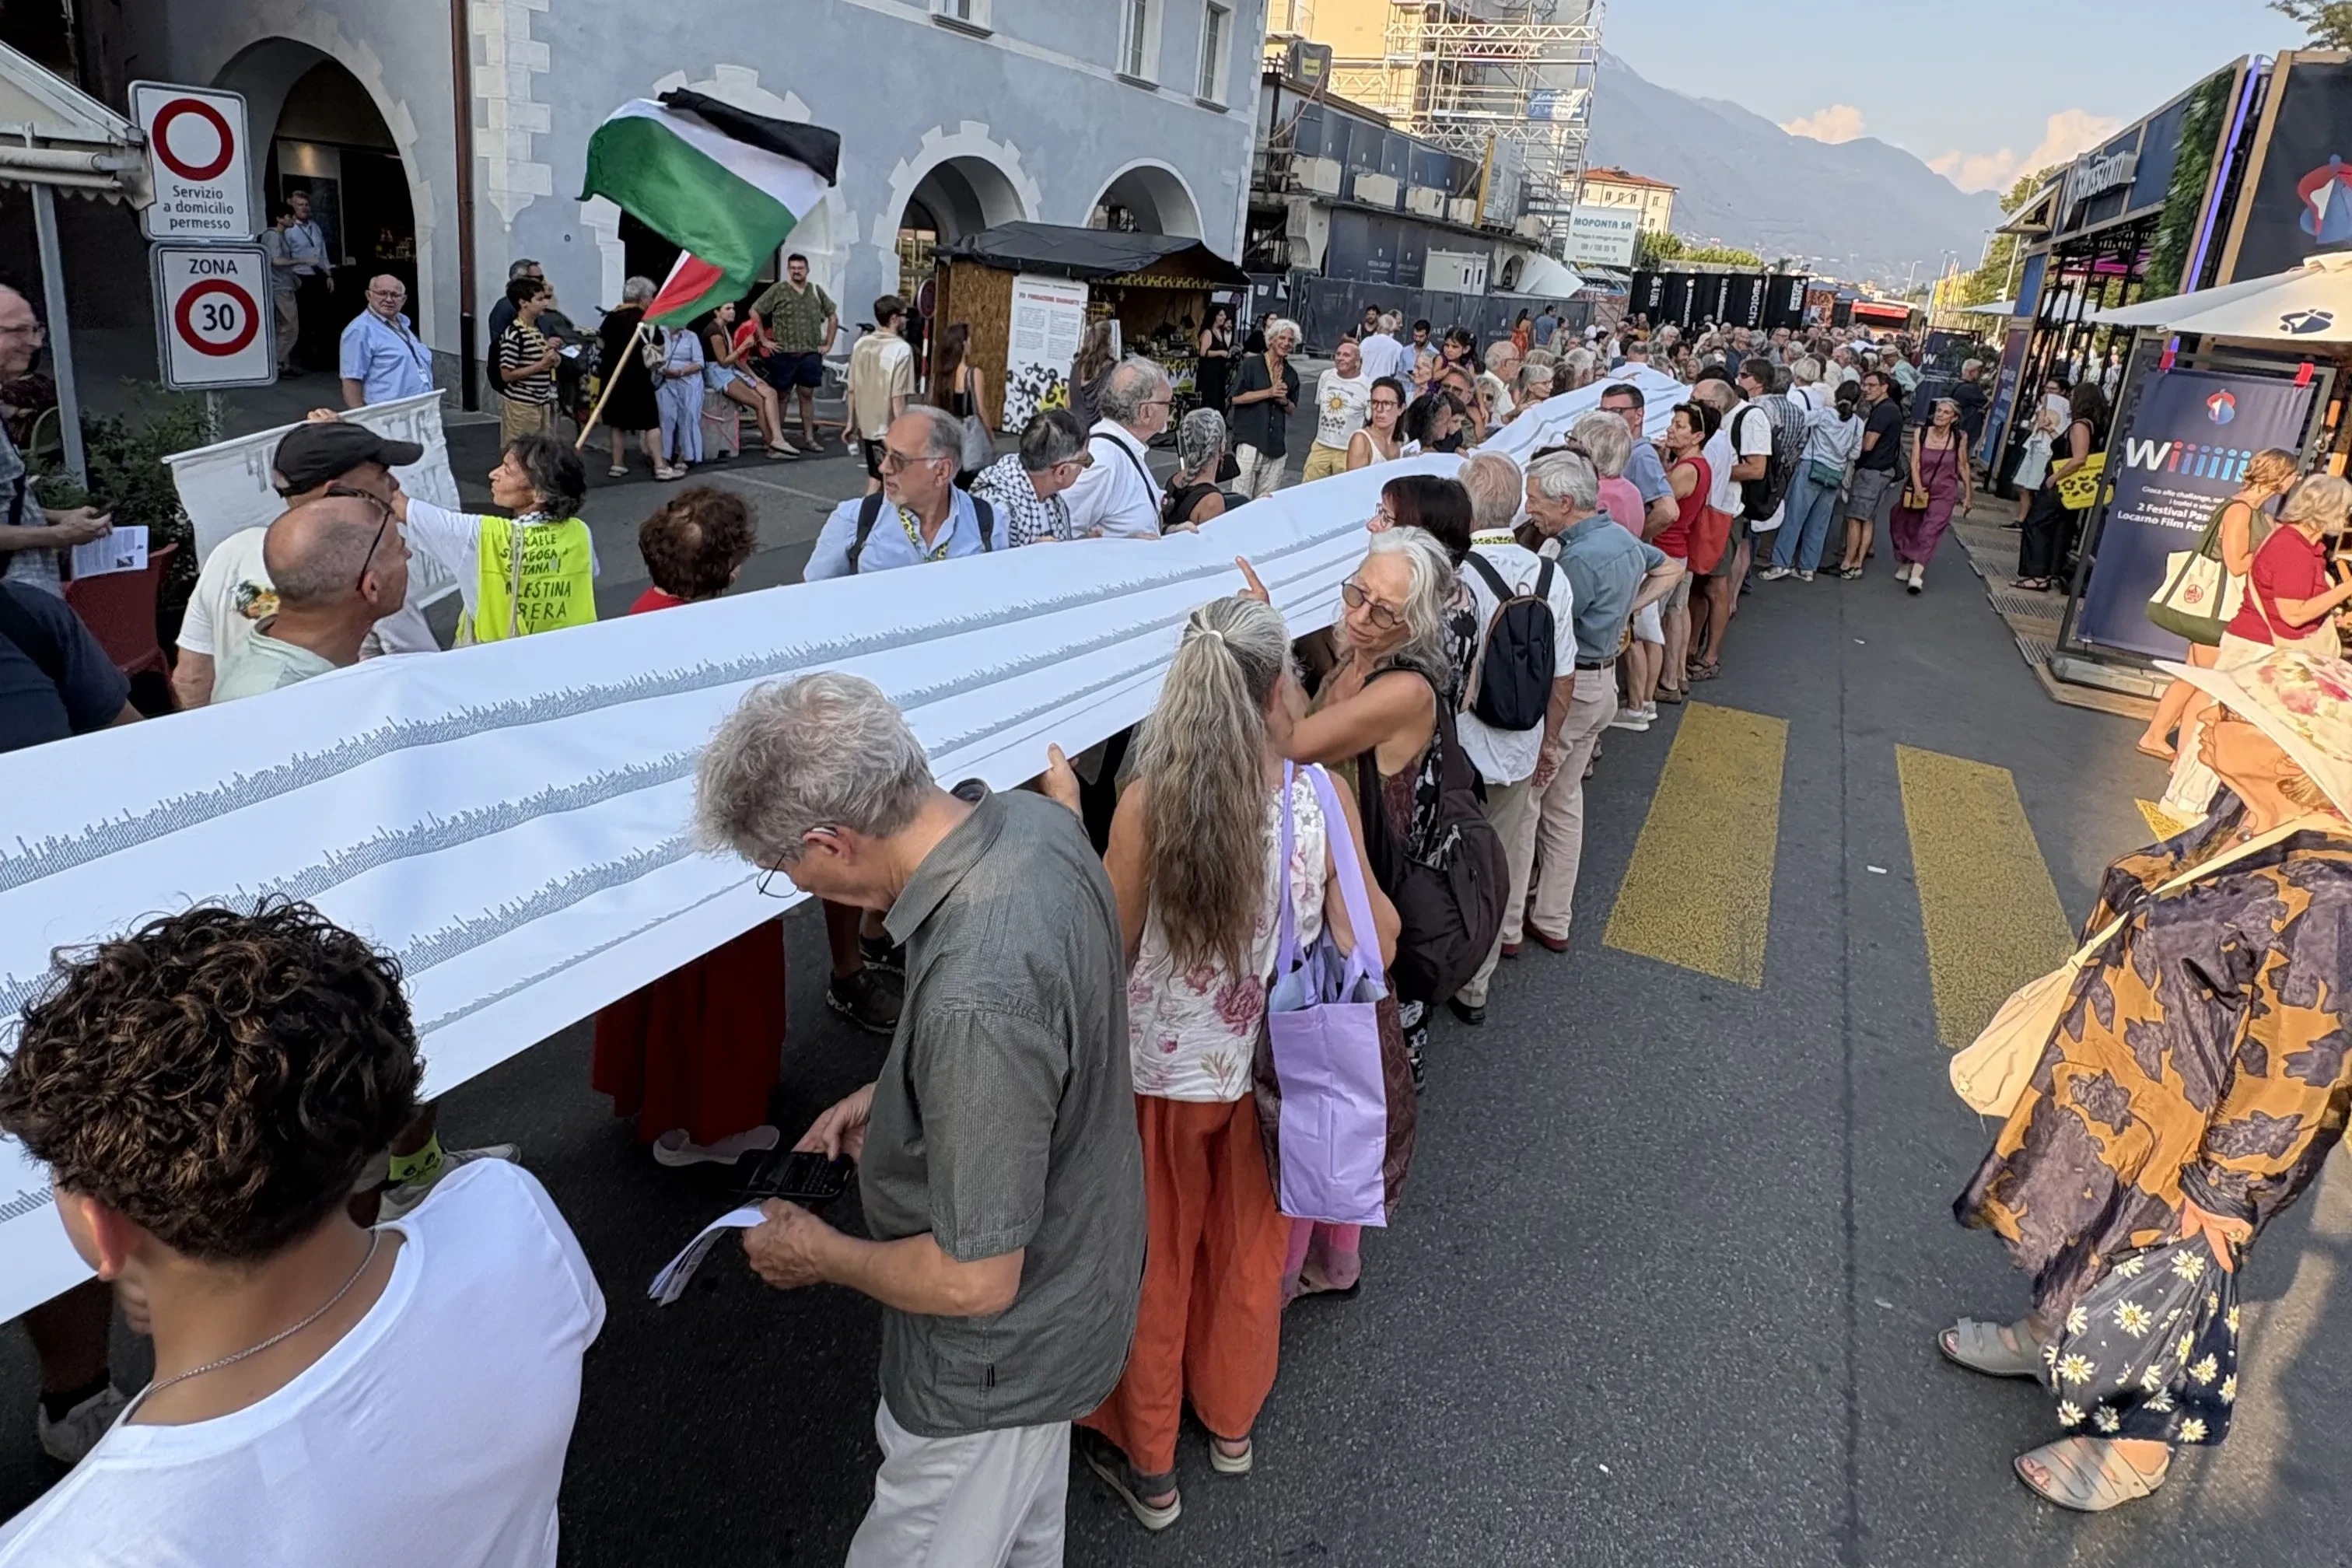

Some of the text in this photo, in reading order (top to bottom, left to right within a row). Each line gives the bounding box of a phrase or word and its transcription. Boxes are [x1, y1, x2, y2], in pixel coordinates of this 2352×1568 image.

[173, 184, 223, 199] Servizio
[163, 201, 233, 215] a domicilio
[170, 218, 231, 230] permesso
[1573, 218, 1632, 230] MOPONTA SA
[188, 258, 238, 275] ZONA
[1649, 288, 1661, 308] UBS
[1748, 279, 1762, 320] swatch
[202, 303, 235, 331] 30
[2137, 502, 2144, 511] 2
[2147, 504, 2187, 519] Festival
[2117, 509, 2208, 533] Locarno Film Fest
